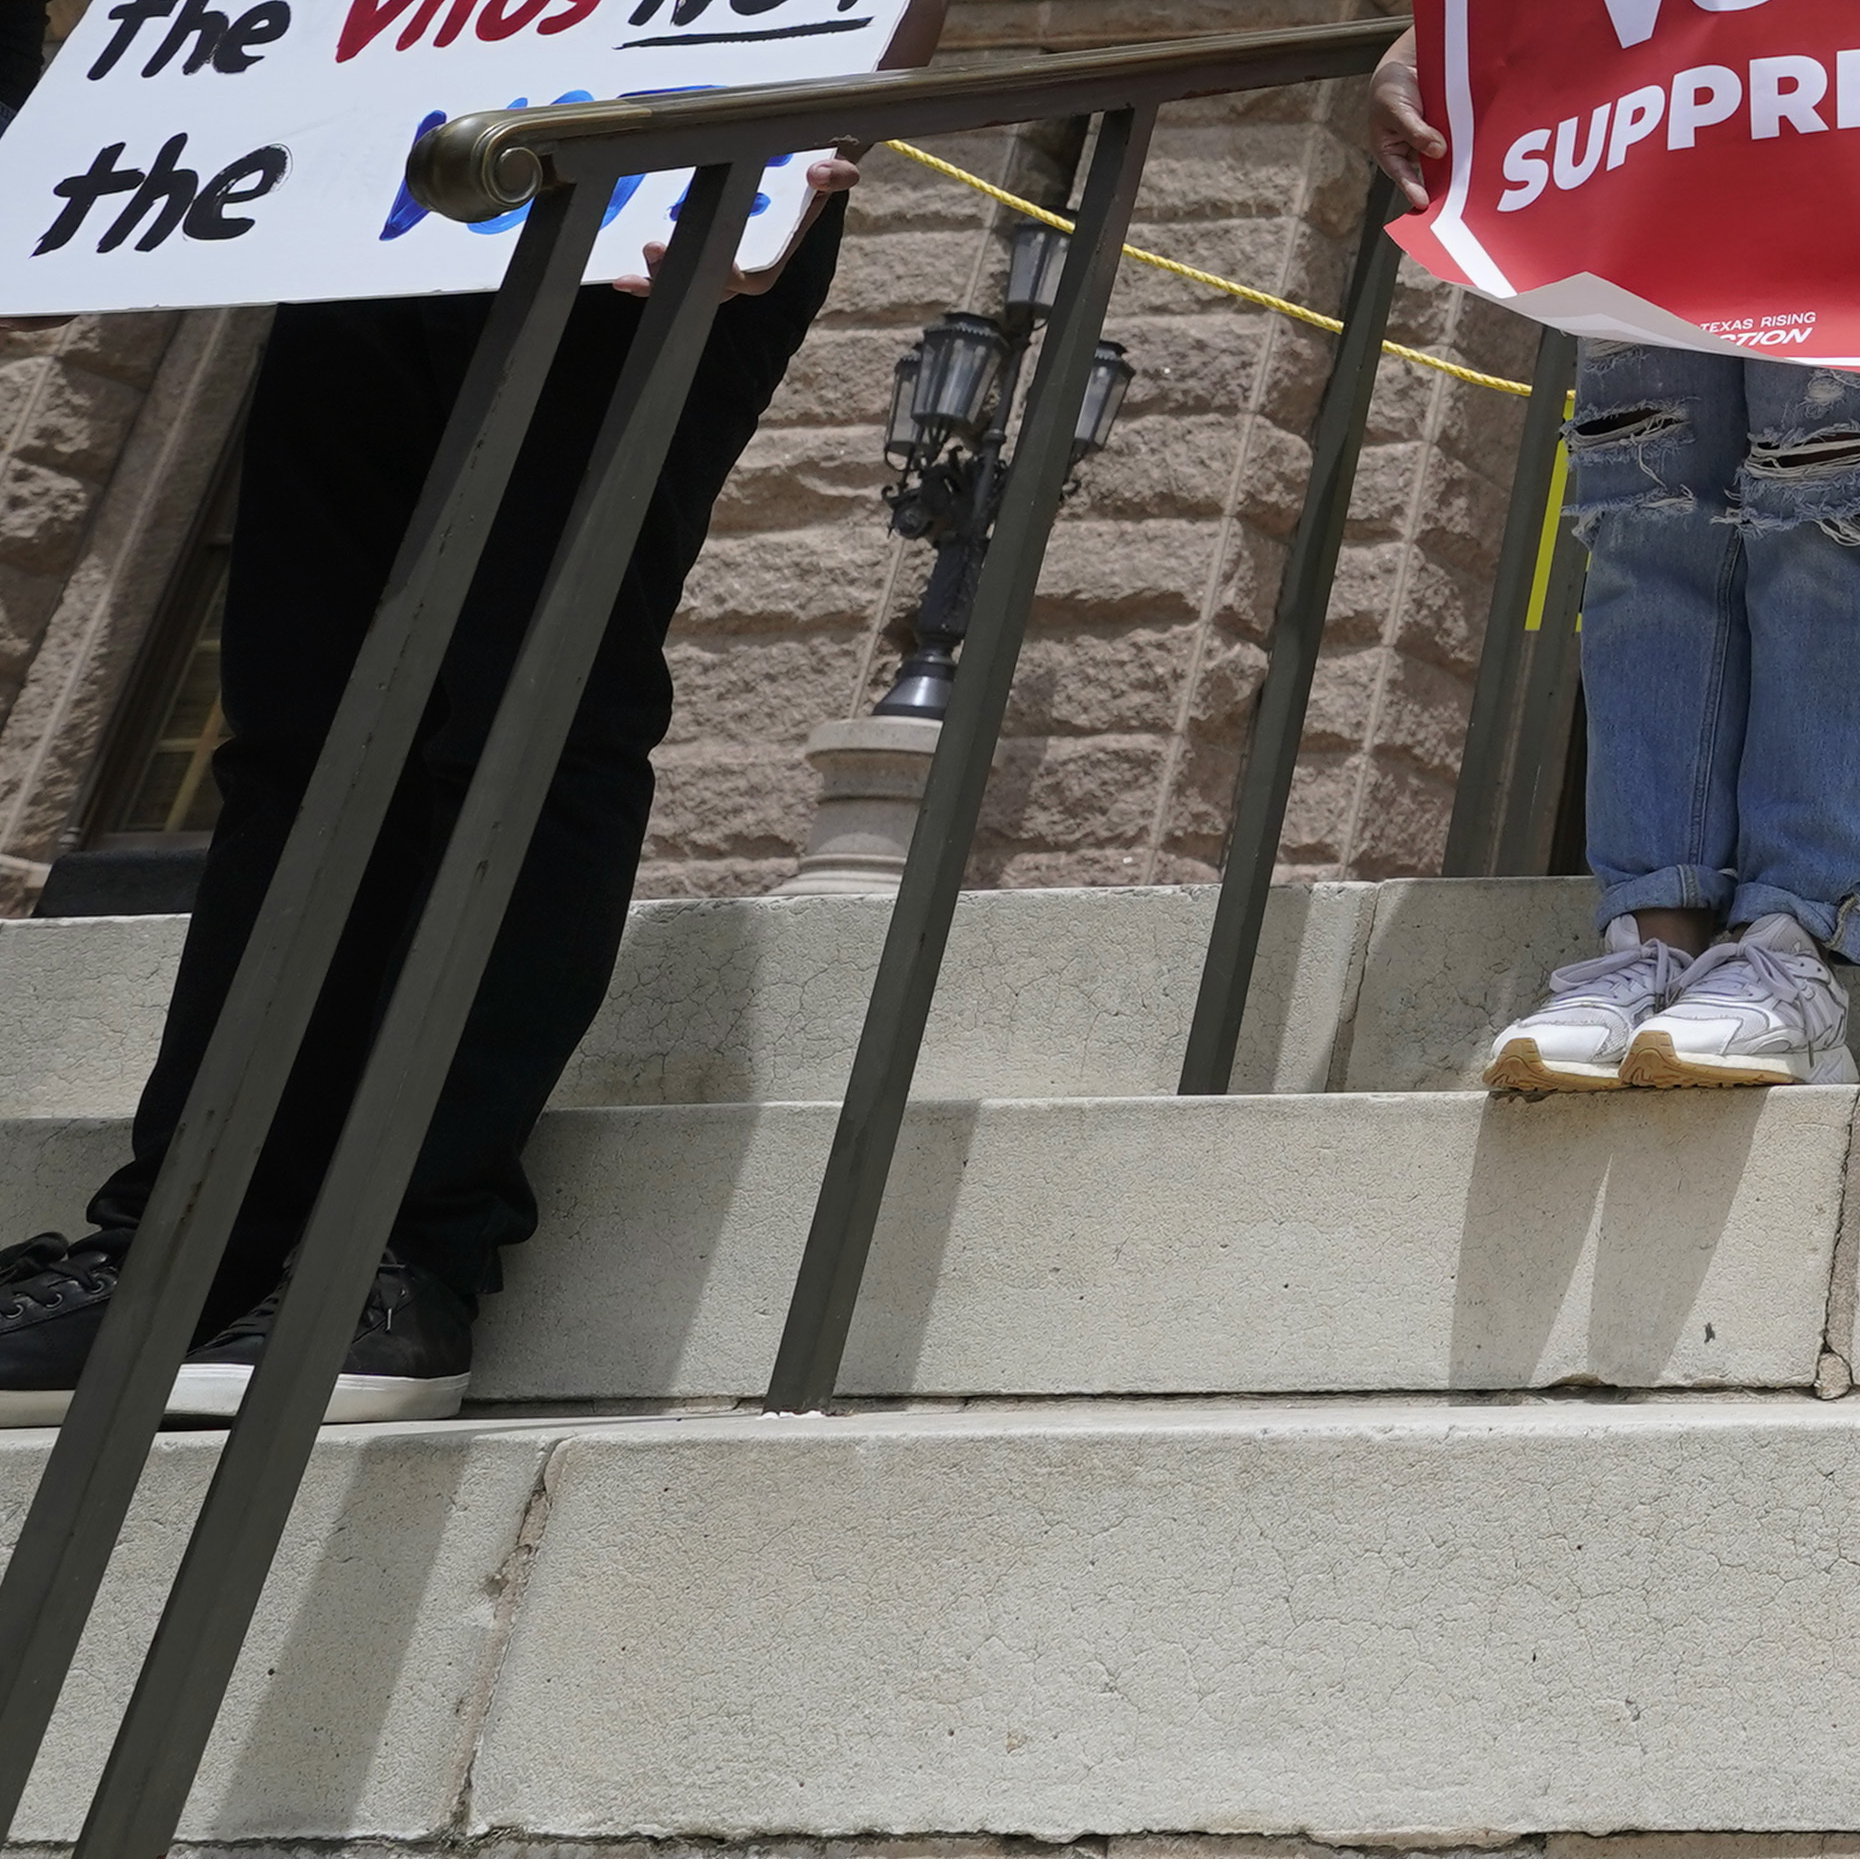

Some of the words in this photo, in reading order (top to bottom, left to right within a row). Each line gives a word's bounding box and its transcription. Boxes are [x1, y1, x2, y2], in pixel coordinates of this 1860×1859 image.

[31, 132, 292, 257] the
[1700, 318, 1754, 333] TEXAS
[1760, 311, 1817, 328] RISING
